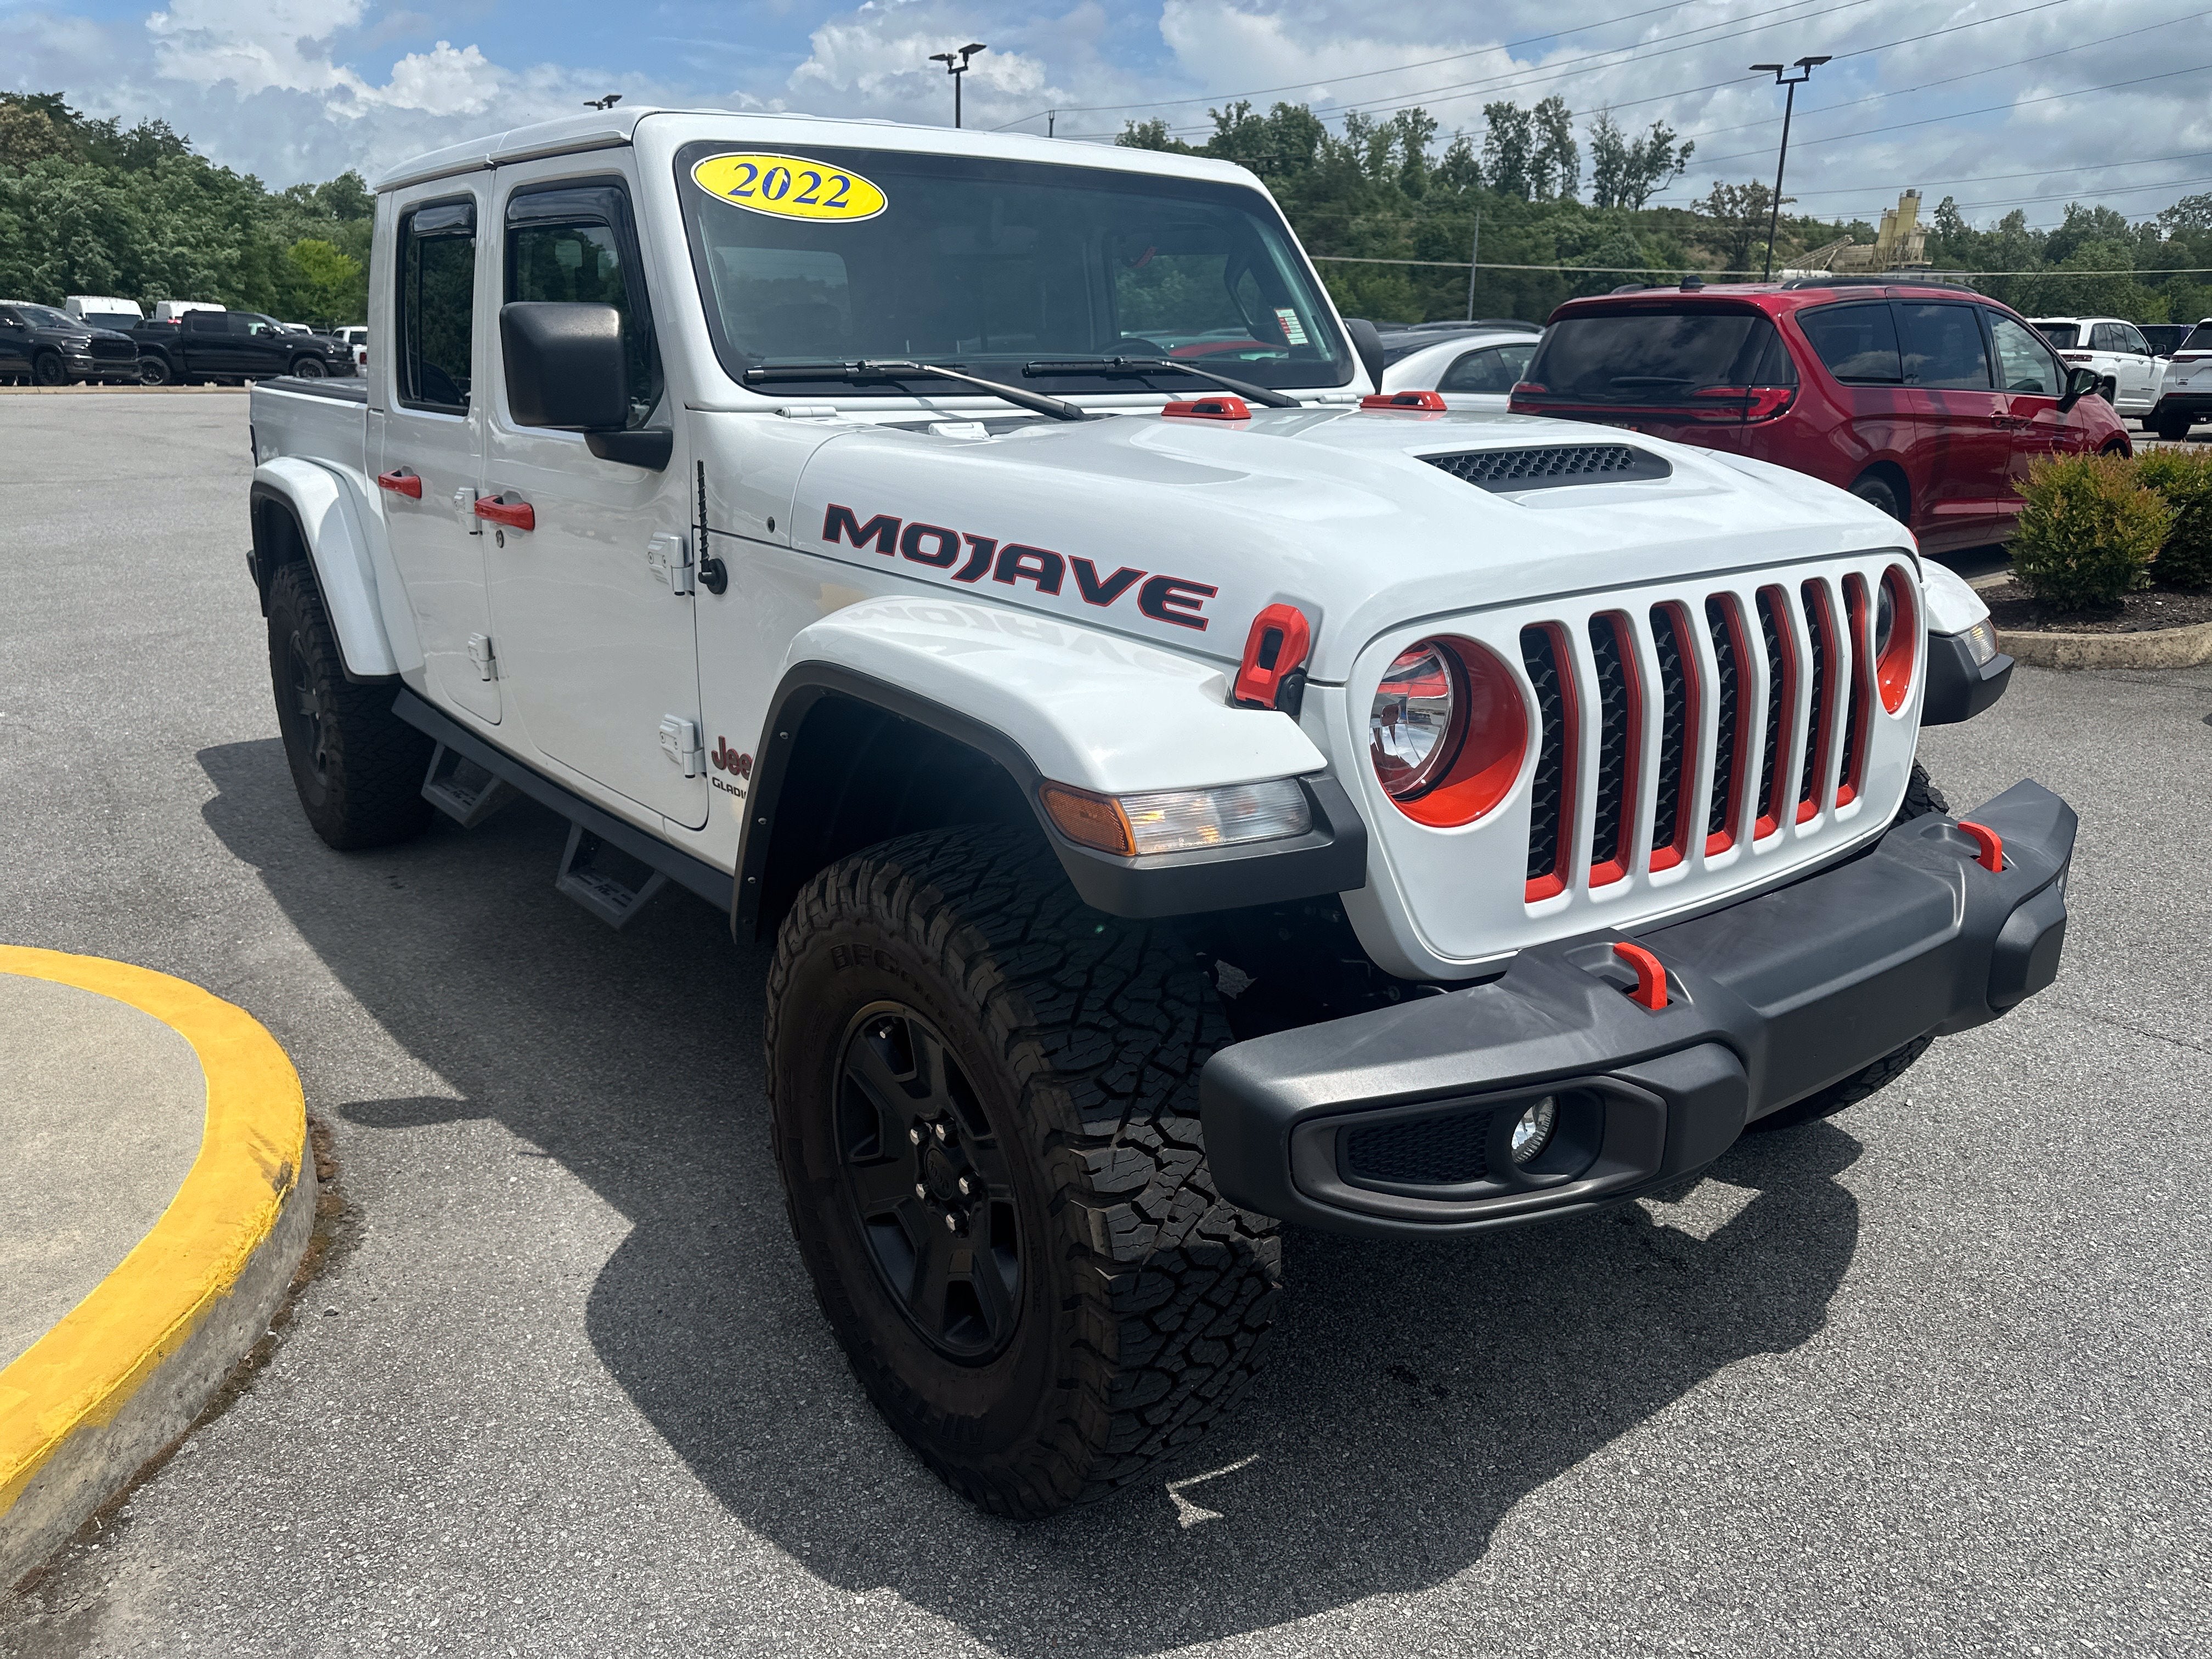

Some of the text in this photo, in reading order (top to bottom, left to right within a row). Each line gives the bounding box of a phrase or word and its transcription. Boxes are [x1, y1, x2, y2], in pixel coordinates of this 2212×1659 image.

[728, 163, 850, 208] 2022
[822, 503, 1218, 632] MOJAVE
[712, 777, 746, 799] GLADI
